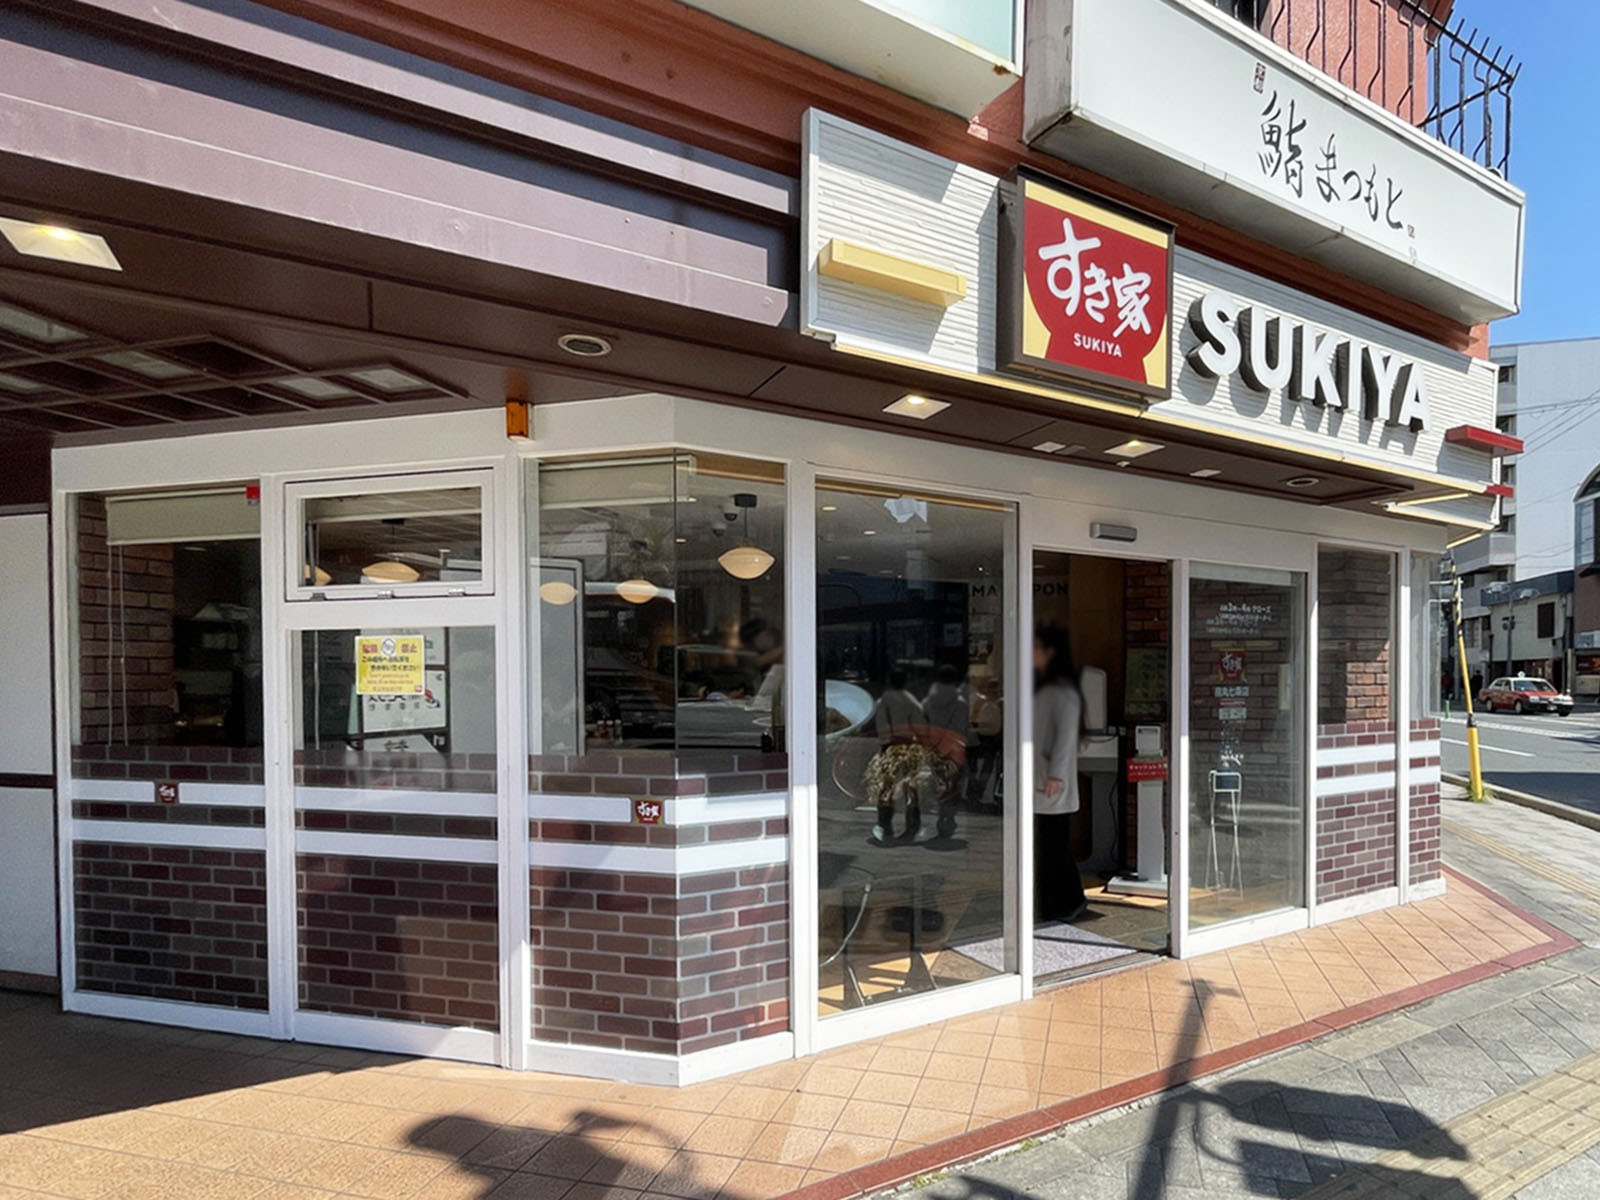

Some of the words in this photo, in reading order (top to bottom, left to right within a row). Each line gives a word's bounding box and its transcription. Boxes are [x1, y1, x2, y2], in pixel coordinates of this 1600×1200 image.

[1038, 217, 1152, 338] すき家
[1073, 332, 1123, 358] SUKIYA
[1198, 290, 1431, 433] SUKIYA
